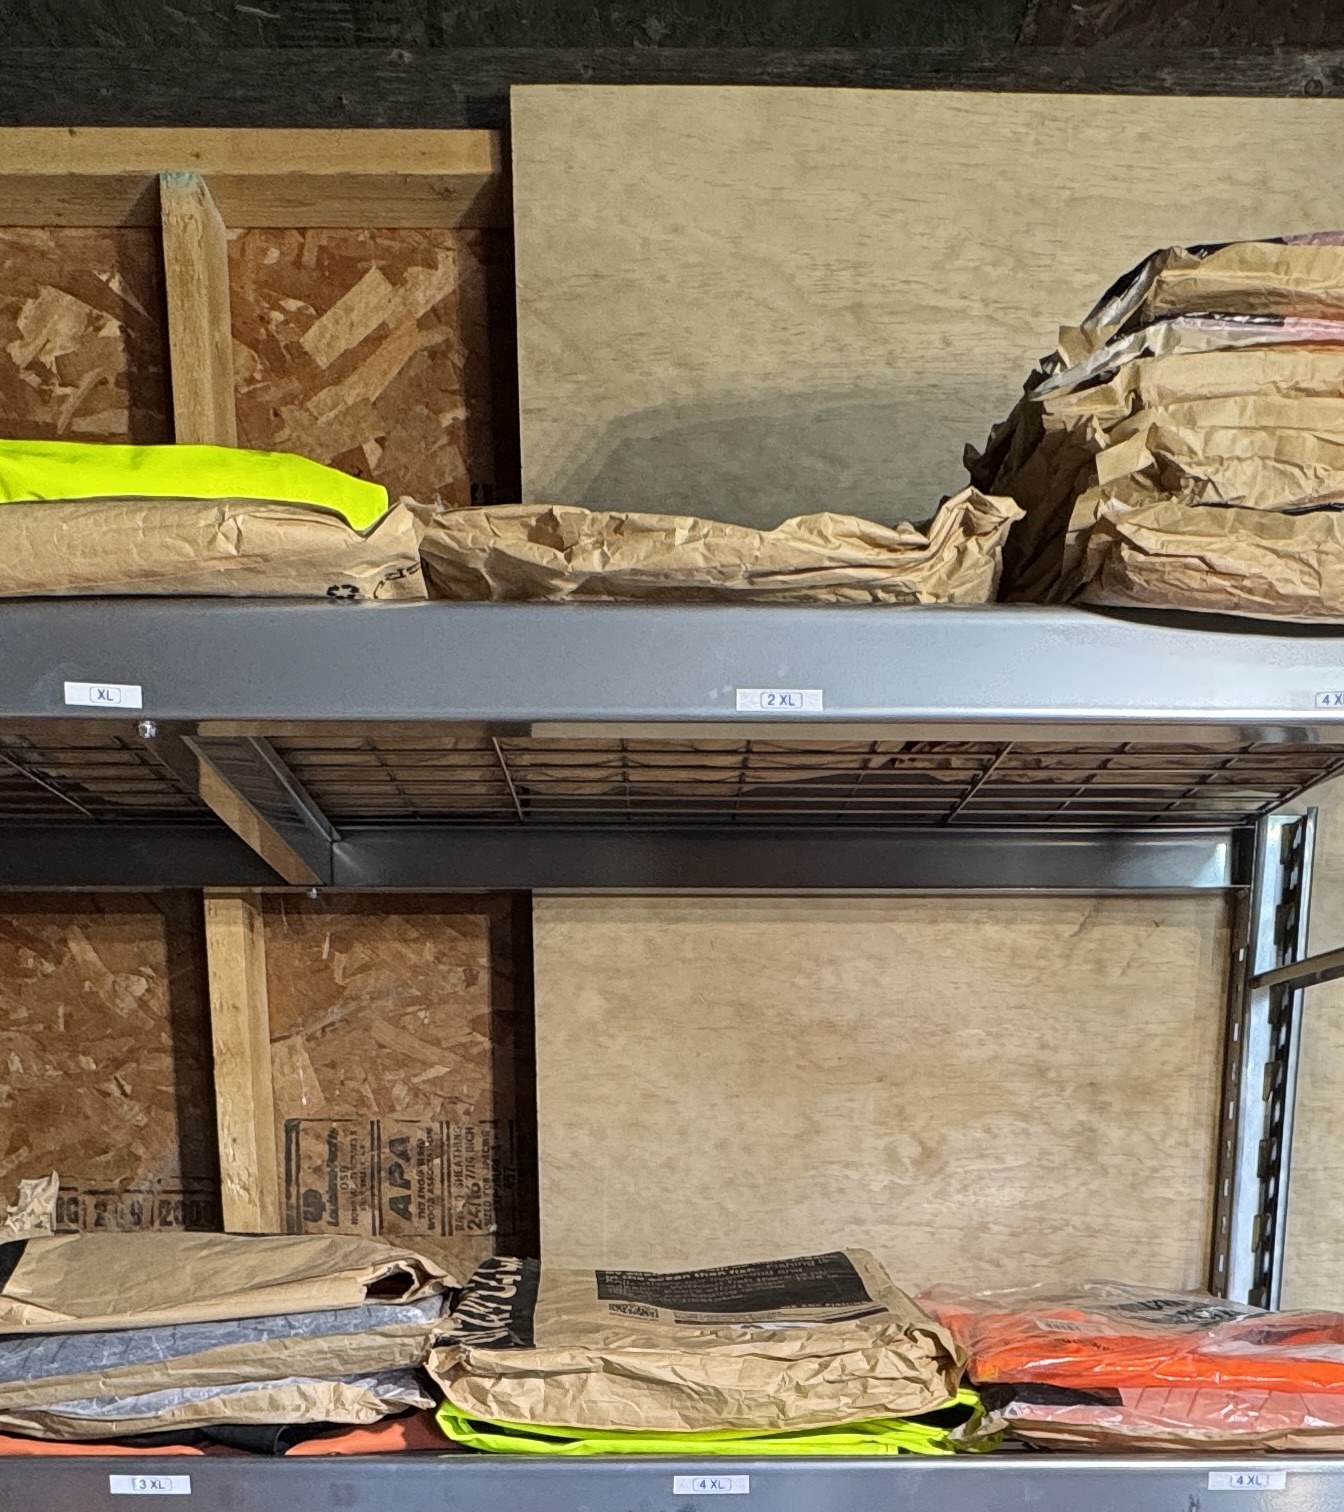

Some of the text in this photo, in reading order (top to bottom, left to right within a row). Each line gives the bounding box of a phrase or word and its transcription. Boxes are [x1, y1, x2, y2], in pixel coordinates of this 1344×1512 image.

[97, 688, 114, 702] XL
[767, 694, 796, 706] 2 XL
[1322, 694, 1331, 705] 4
[453, 1125, 464, 1189] SHEATHING
[388, 1135, 413, 1222] APA
[139, 1479, 166, 1490] 3 XL
[699, 1479, 726, 1490] 4 XL
[1236, 1475, 1262, 1486] 4 XL
